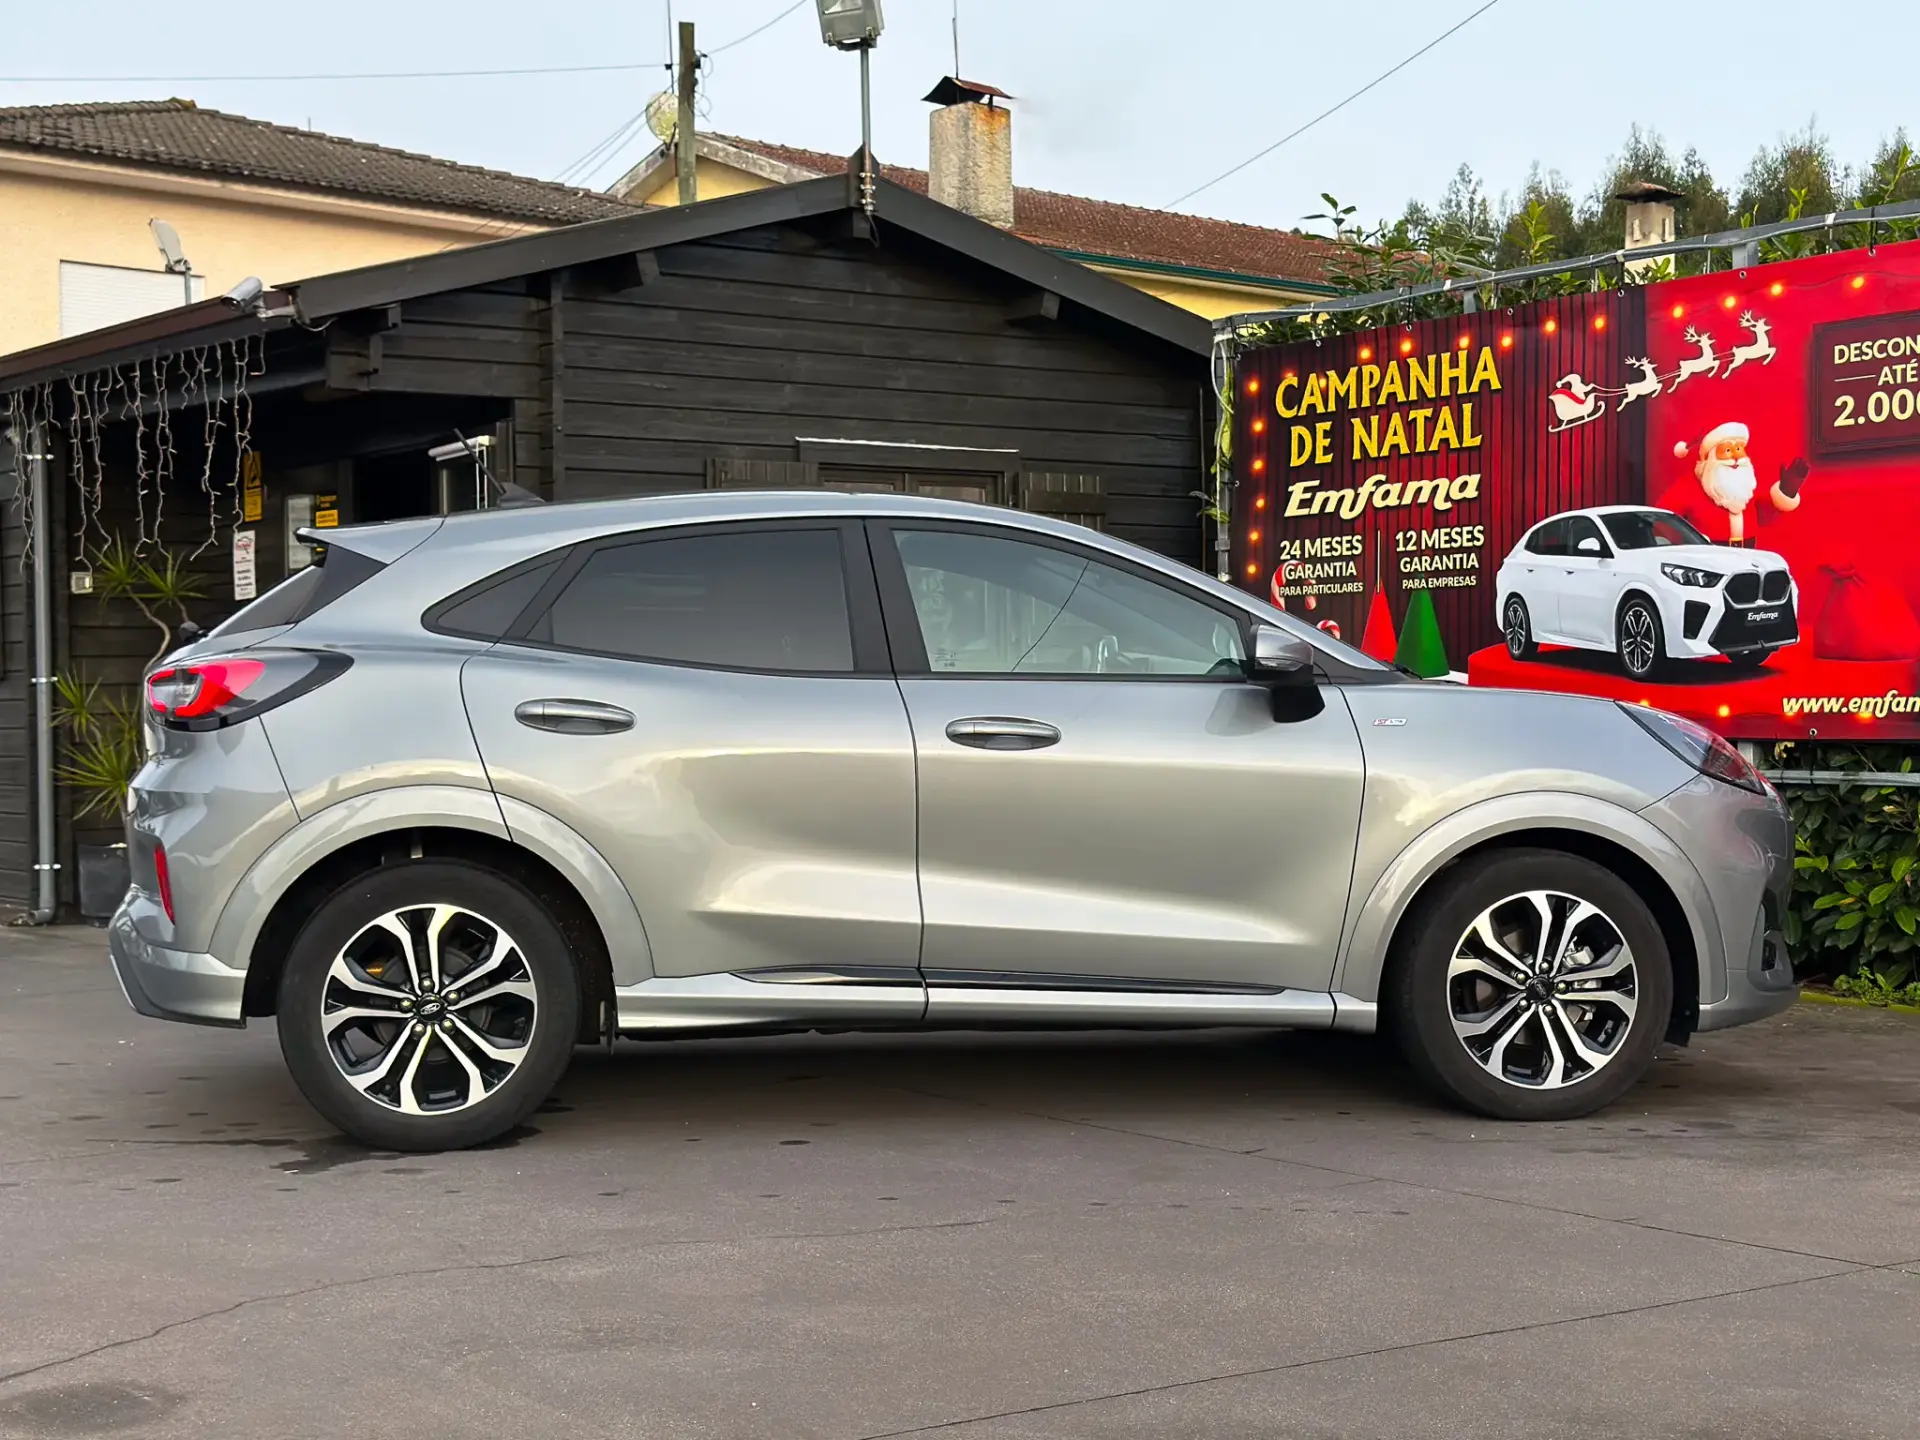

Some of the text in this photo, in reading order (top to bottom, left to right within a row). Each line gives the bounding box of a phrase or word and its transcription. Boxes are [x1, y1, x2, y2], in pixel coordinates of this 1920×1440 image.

[1834, 334, 1920, 365] DESCON
[1275, 346, 1502, 419] CAMPANHA
[1877, 358, 1919, 386] ATÉ
[1833, 388, 1920, 427] 2.00
[1290, 403, 1483, 467] DE NATAL
[1284, 473, 1481, 520] Emfama
[1279, 535, 1363, 561] 24 MESES
[1395, 525, 1485, 552] 12 MESES
[1285, 561, 1357, 581] GARANTIA
[1400, 552, 1480, 573] GARANTIA
[1279, 582, 1364, 597] PARA PARTICULARES
[1402, 575, 1477, 590] PARA EMPRESAS
[1747, 611, 1779, 621] Emfama
